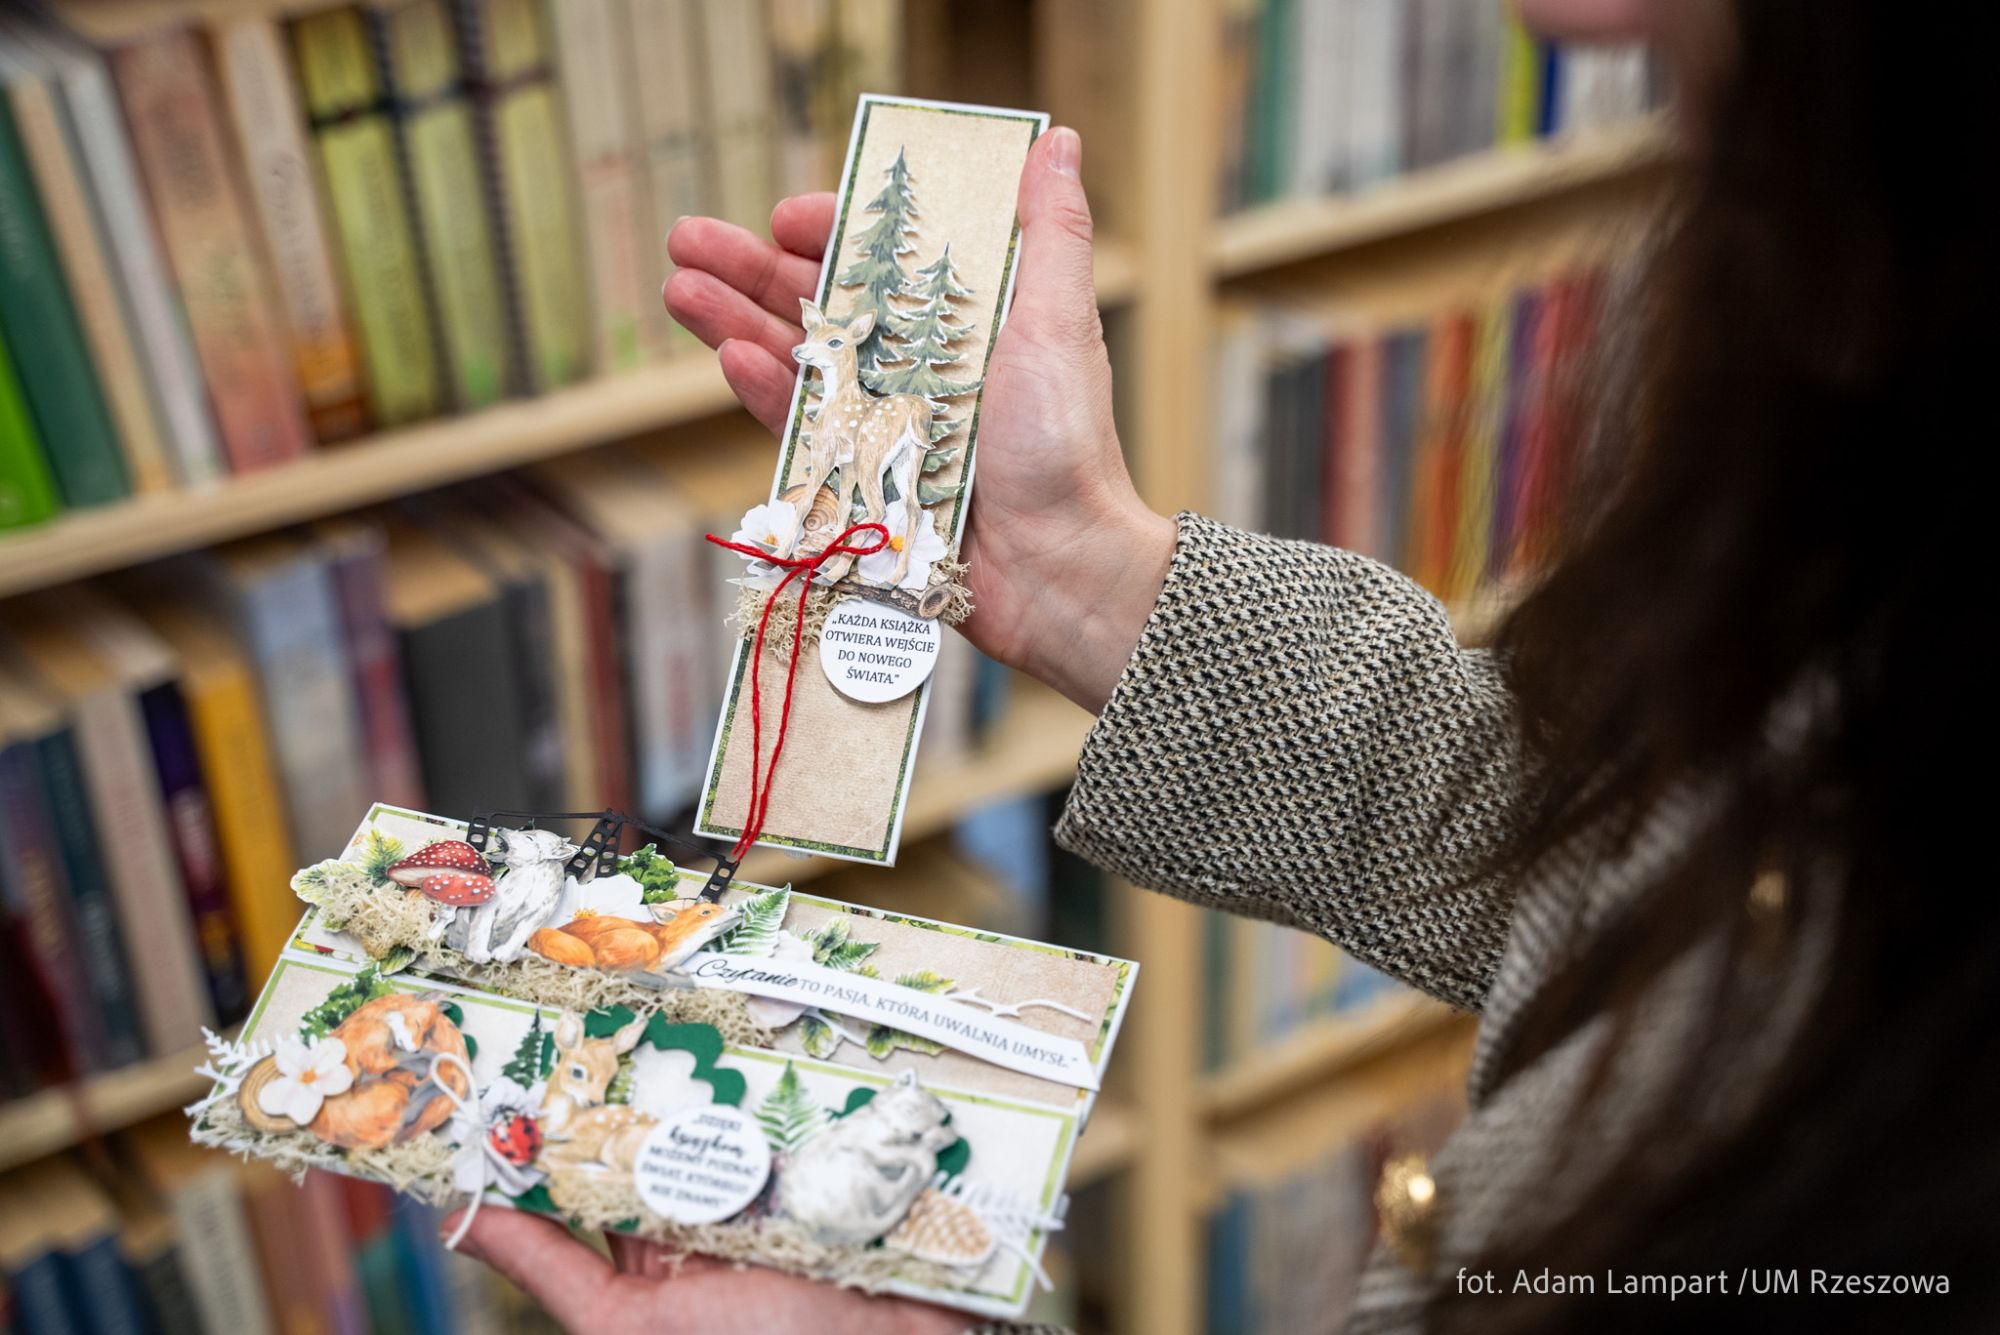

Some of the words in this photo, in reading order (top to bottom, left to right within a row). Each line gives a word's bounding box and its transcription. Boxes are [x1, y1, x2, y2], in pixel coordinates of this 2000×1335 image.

[832, 613, 877, 629] „KAŻDA
[880, 618, 931, 635] KSIĄŻKA
[825, 629, 882, 647] OTWIERA
[885, 637, 936, 653] WEJŚCIE
[837, 649, 855, 661] DO
[858, 651, 912, 668] NOWEGO
[693, 958, 799, 989] Czytanie
[800, 978, 820, 993] TO
[823, 986, 871, 1008] PASJA,
[876, 997, 929, 1023] KTÓRA
[933, 1013, 1009, 1052] UWALNIA
